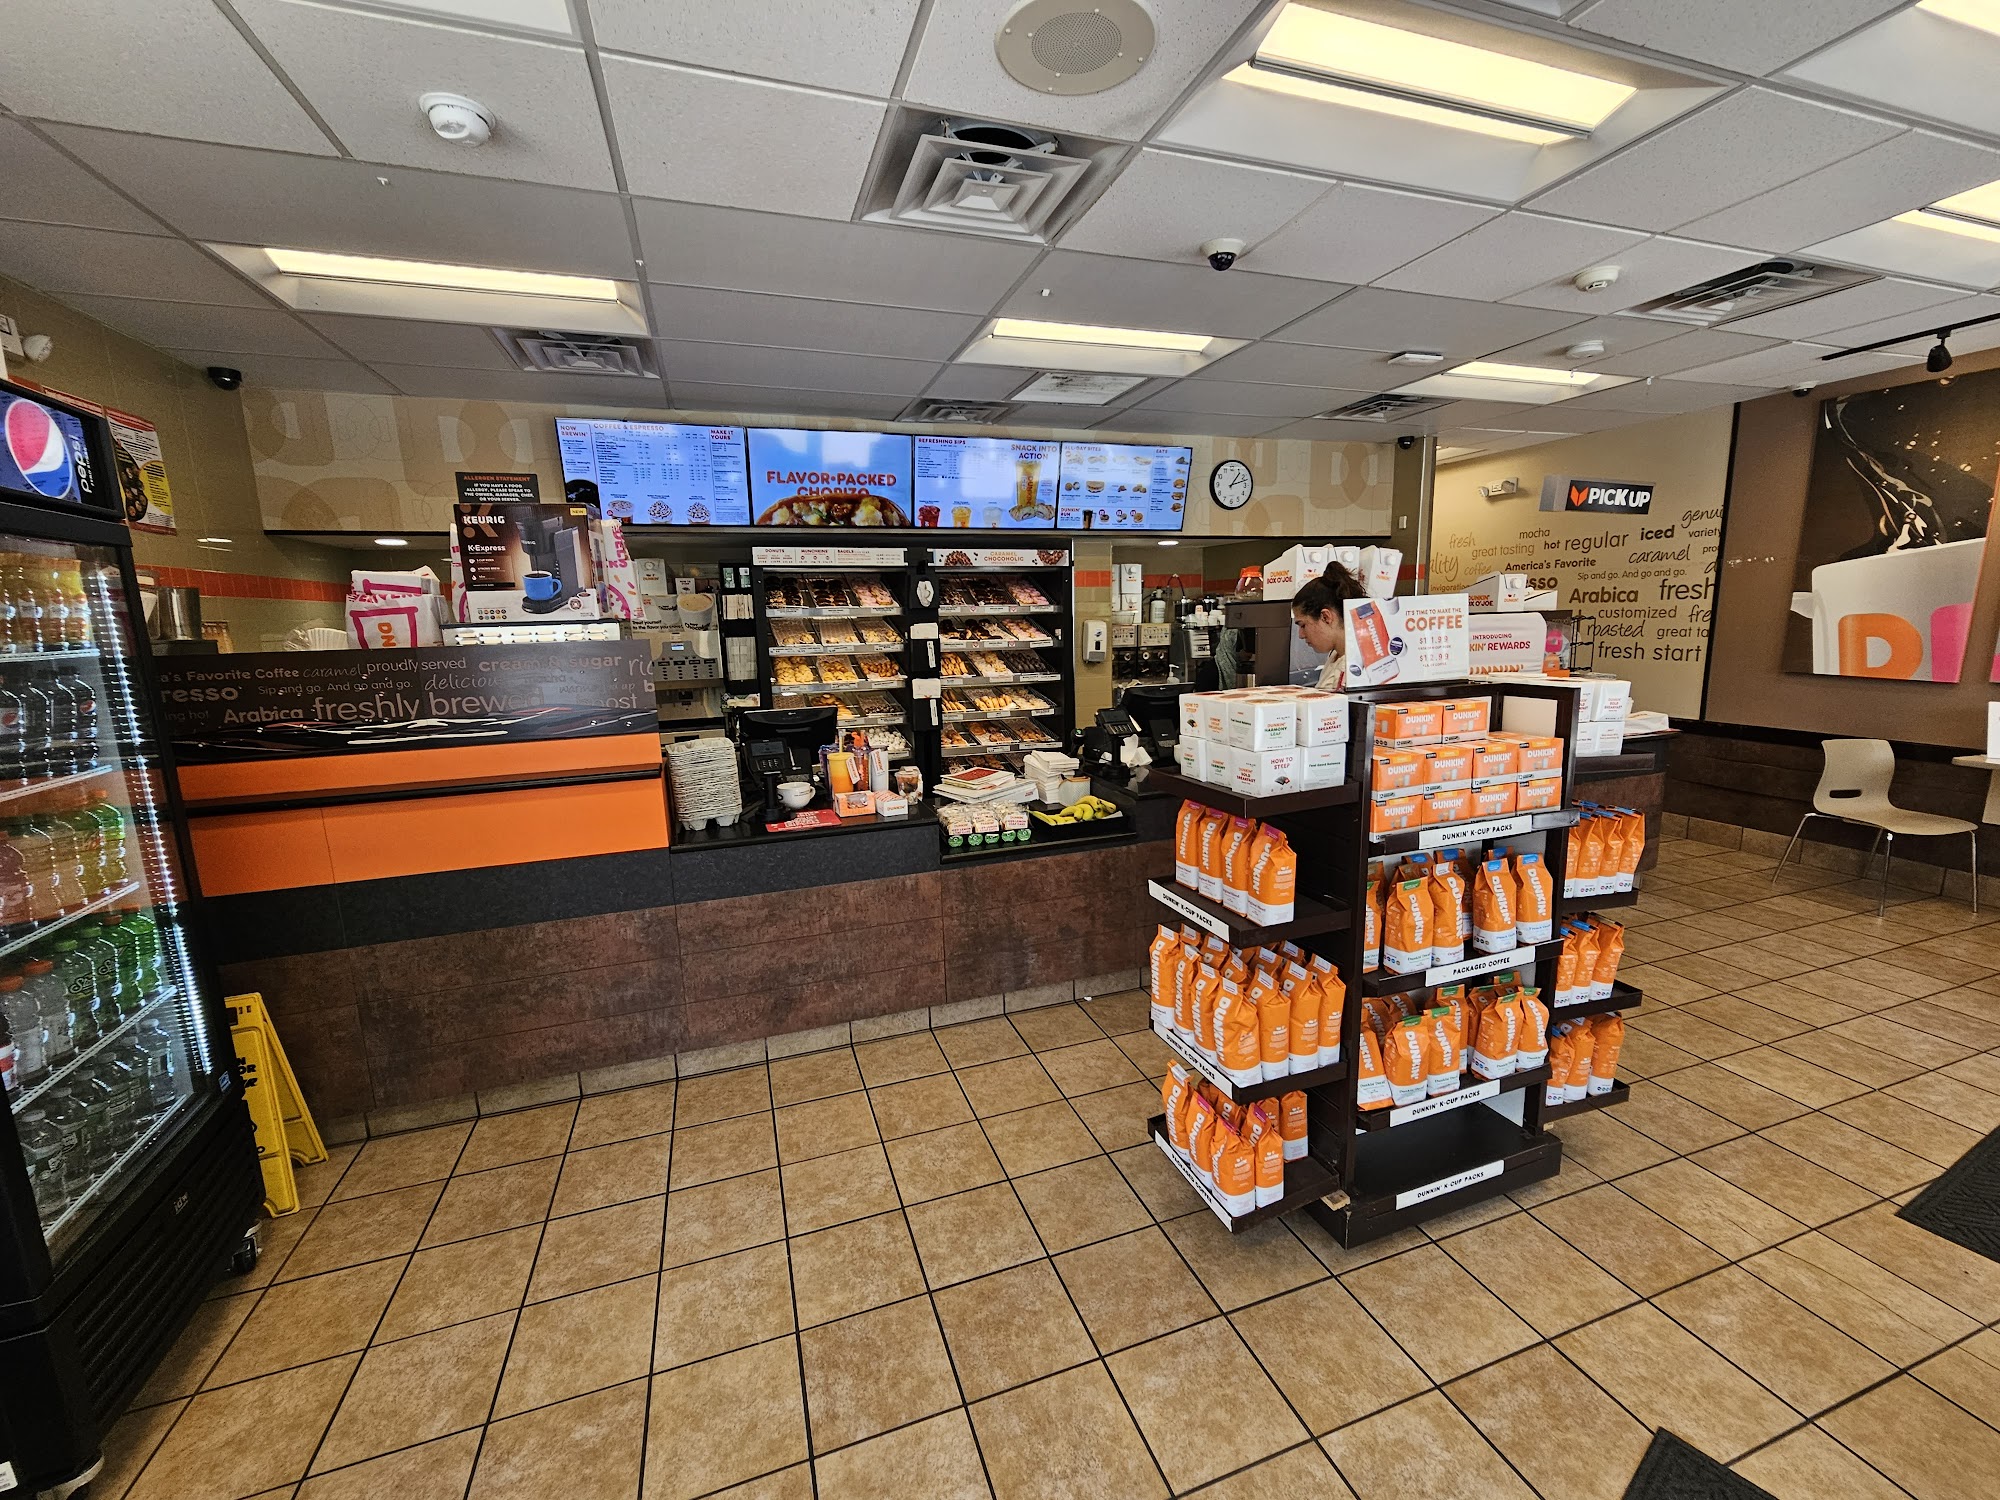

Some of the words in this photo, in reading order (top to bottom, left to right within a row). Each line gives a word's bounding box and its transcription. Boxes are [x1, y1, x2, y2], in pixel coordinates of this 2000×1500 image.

[68, 434, 92, 493] pepsi
[1018, 452, 1048, 460] ACTION
[463, 515, 505, 524] KEURIG
[1519, 527, 1550, 539] mocha
[1640, 524, 1675, 540] iced
[1449, 532, 1476, 549] fresh
[1544, 540, 1561, 549] hot
[1564, 530, 1629, 554] regular
[1472, 545, 1497, 560] great
[1500, 543, 1535, 556] tasting
[1628, 544, 1691, 564] caramel
[1463, 562, 1492, 576] coffee
[1505, 560, 1551, 571] America's
[1554, 558, 1597, 569] Favorite
[1578, 572, 1589, 581] Sip
[1590, 570, 1606, 579] and
[1608, 572, 1619, 581] go.
[1622, 568, 1639, 578] And
[1640, 571, 1652, 580] go
[1653, 567, 1671, 577] and
[1673, 569, 1687, 579] go.
[1569, 586, 1639, 604] Arabica
[1598, 605, 1678, 619] customized
[1405, 615, 1463, 632] COFFEE
[1587, 620, 1646, 637] roasted
[1657, 627, 1692, 640] great
[1487, 641, 1531, 651] REWARDS
[1598, 641, 1644, 660] fresh
[1653, 644, 1702, 662] start
[303, 664, 362, 678] caramel
[367, 659, 418, 675] proudly
[422, 657, 466, 670] served
[479, 659, 540, 672] cream
[569, 656, 621, 669] sugar
[186, 670, 250, 681] Favorite
[255, 668, 298, 679] Coffee
[258, 686, 276, 696] Sip
[282, 684, 302, 694] and
[306, 685, 323, 694] go.
[328, 682, 350, 691] And
[372, 679, 393, 689] and
[397, 681, 412, 689] go.
[313, 692, 419, 720] freshly
[429, 688, 544, 715] brewed
[224, 706, 303, 723] Arabica
[1406, 714, 1435, 724] DUNKIN'
[1453, 710, 1481, 720] DUNKIN'
[1483, 752, 1512, 763] DUNKIN'
[1527, 748, 1556, 758] DUNKIN'
[1388, 763, 1418, 775] DUNKIN'
[1434, 758, 1466, 768] DUNKIN'
[1480, 792, 1509, 802] DUNKIN'
[1527, 786, 1555, 796] DUNKIN'
[1385, 805, 1415, 816] DUNKIN'
[1432, 798, 1463, 809] DUNKIN'
[1442, 830, 1469, 840] DUNKIN'
[1470, 827, 1490, 836] K-CUP
[1492, 824, 1513, 832] PACKS
[1202, 822, 1216, 870] DUNKIN'
[1225, 832, 1242, 882] DUNKIN'
[1492, 876, 1511, 924] DUNKIN'
[1528, 868, 1546, 916] DUNKIN'
[1409, 893, 1424, 944] DUNKIN'
[1453, 962, 1487, 975] PACKAGED
[1488, 957, 1510, 968] COFFEE
[1527, 1000, 1545, 1047] DUNKIN'
[1435, 1021, 1452, 1067] DUNKIN'
[1405, 1030, 1421, 1079] DUNKIN'
[1412, 1103, 1438, 1116] DUNKIN'
[1439, 1097, 1459, 1108] K-CUP
[1460, 1090, 1481, 1102] PACKS
[1416, 1185, 1443, 1198] DUNKIN'
[1463, 1170, 1485, 1183] PACKS
